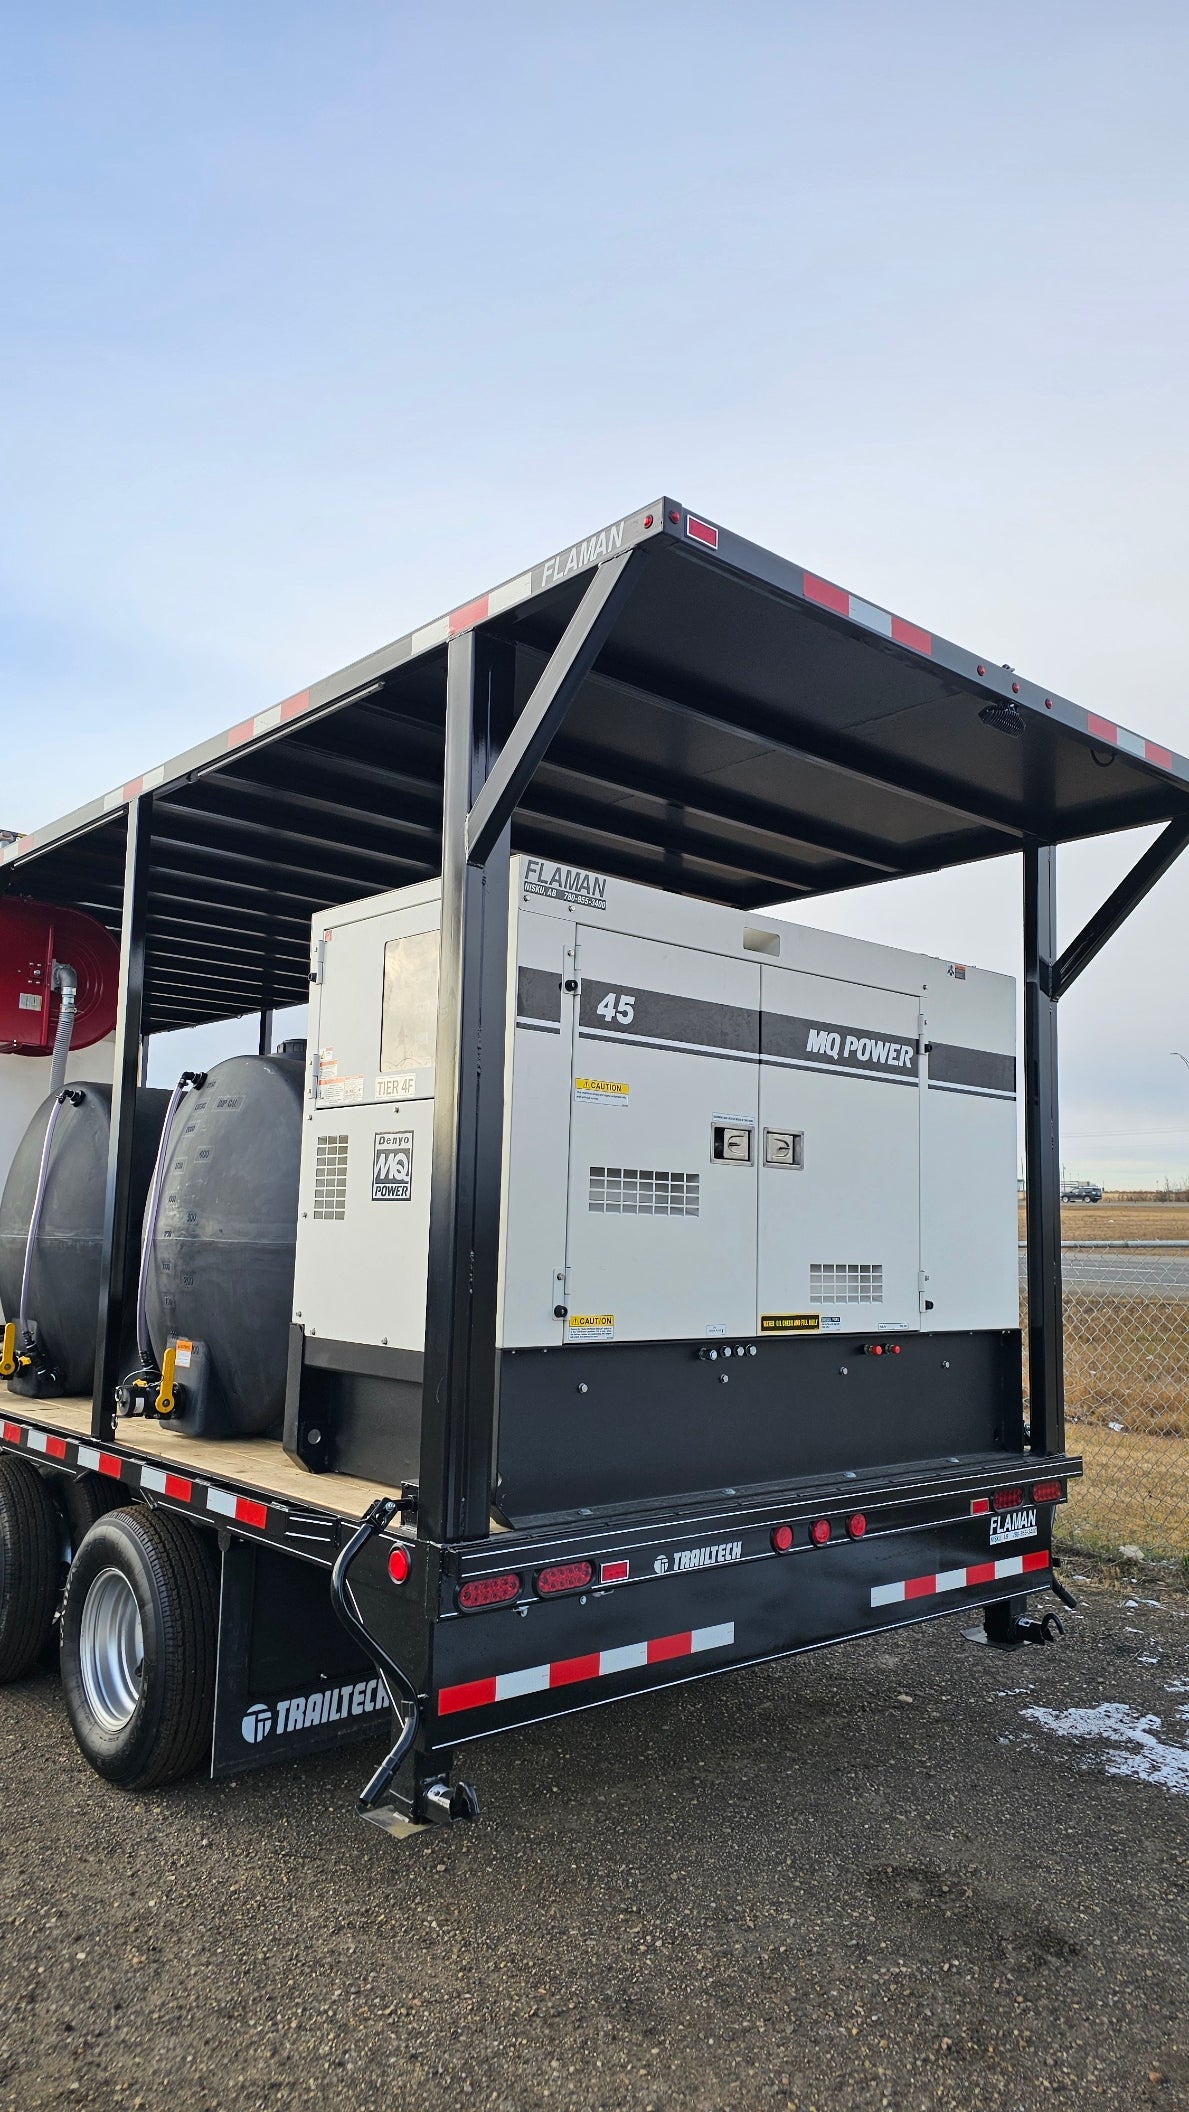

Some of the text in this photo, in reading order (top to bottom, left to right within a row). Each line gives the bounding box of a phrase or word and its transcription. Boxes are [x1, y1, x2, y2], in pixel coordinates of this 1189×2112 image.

[541, 521, 625, 587] FLAMAN
[525, 859, 606, 898] FLAMAN
[547, 888, 557, 897] AB
[563, 892, 606, 909] 780-955-3400
[596, 992, 635, 1025] 45
[806, 1028, 914, 1068] MQ POWER
[377, 1080, 399, 1096] TIER
[401, 1078, 414, 1094] 4F
[590, 1081, 622, 1092] CAUTION
[378, 1135, 410, 1147] Denyo
[374, 1152, 409, 1181] MQ
[374, 1185, 409, 1197] POWER
[579, 1317, 612, 1325] CAUTION
[990, 1508, 1037, 1535] FLAMAN
[673, 1541, 742, 1571] TRAILTECH
